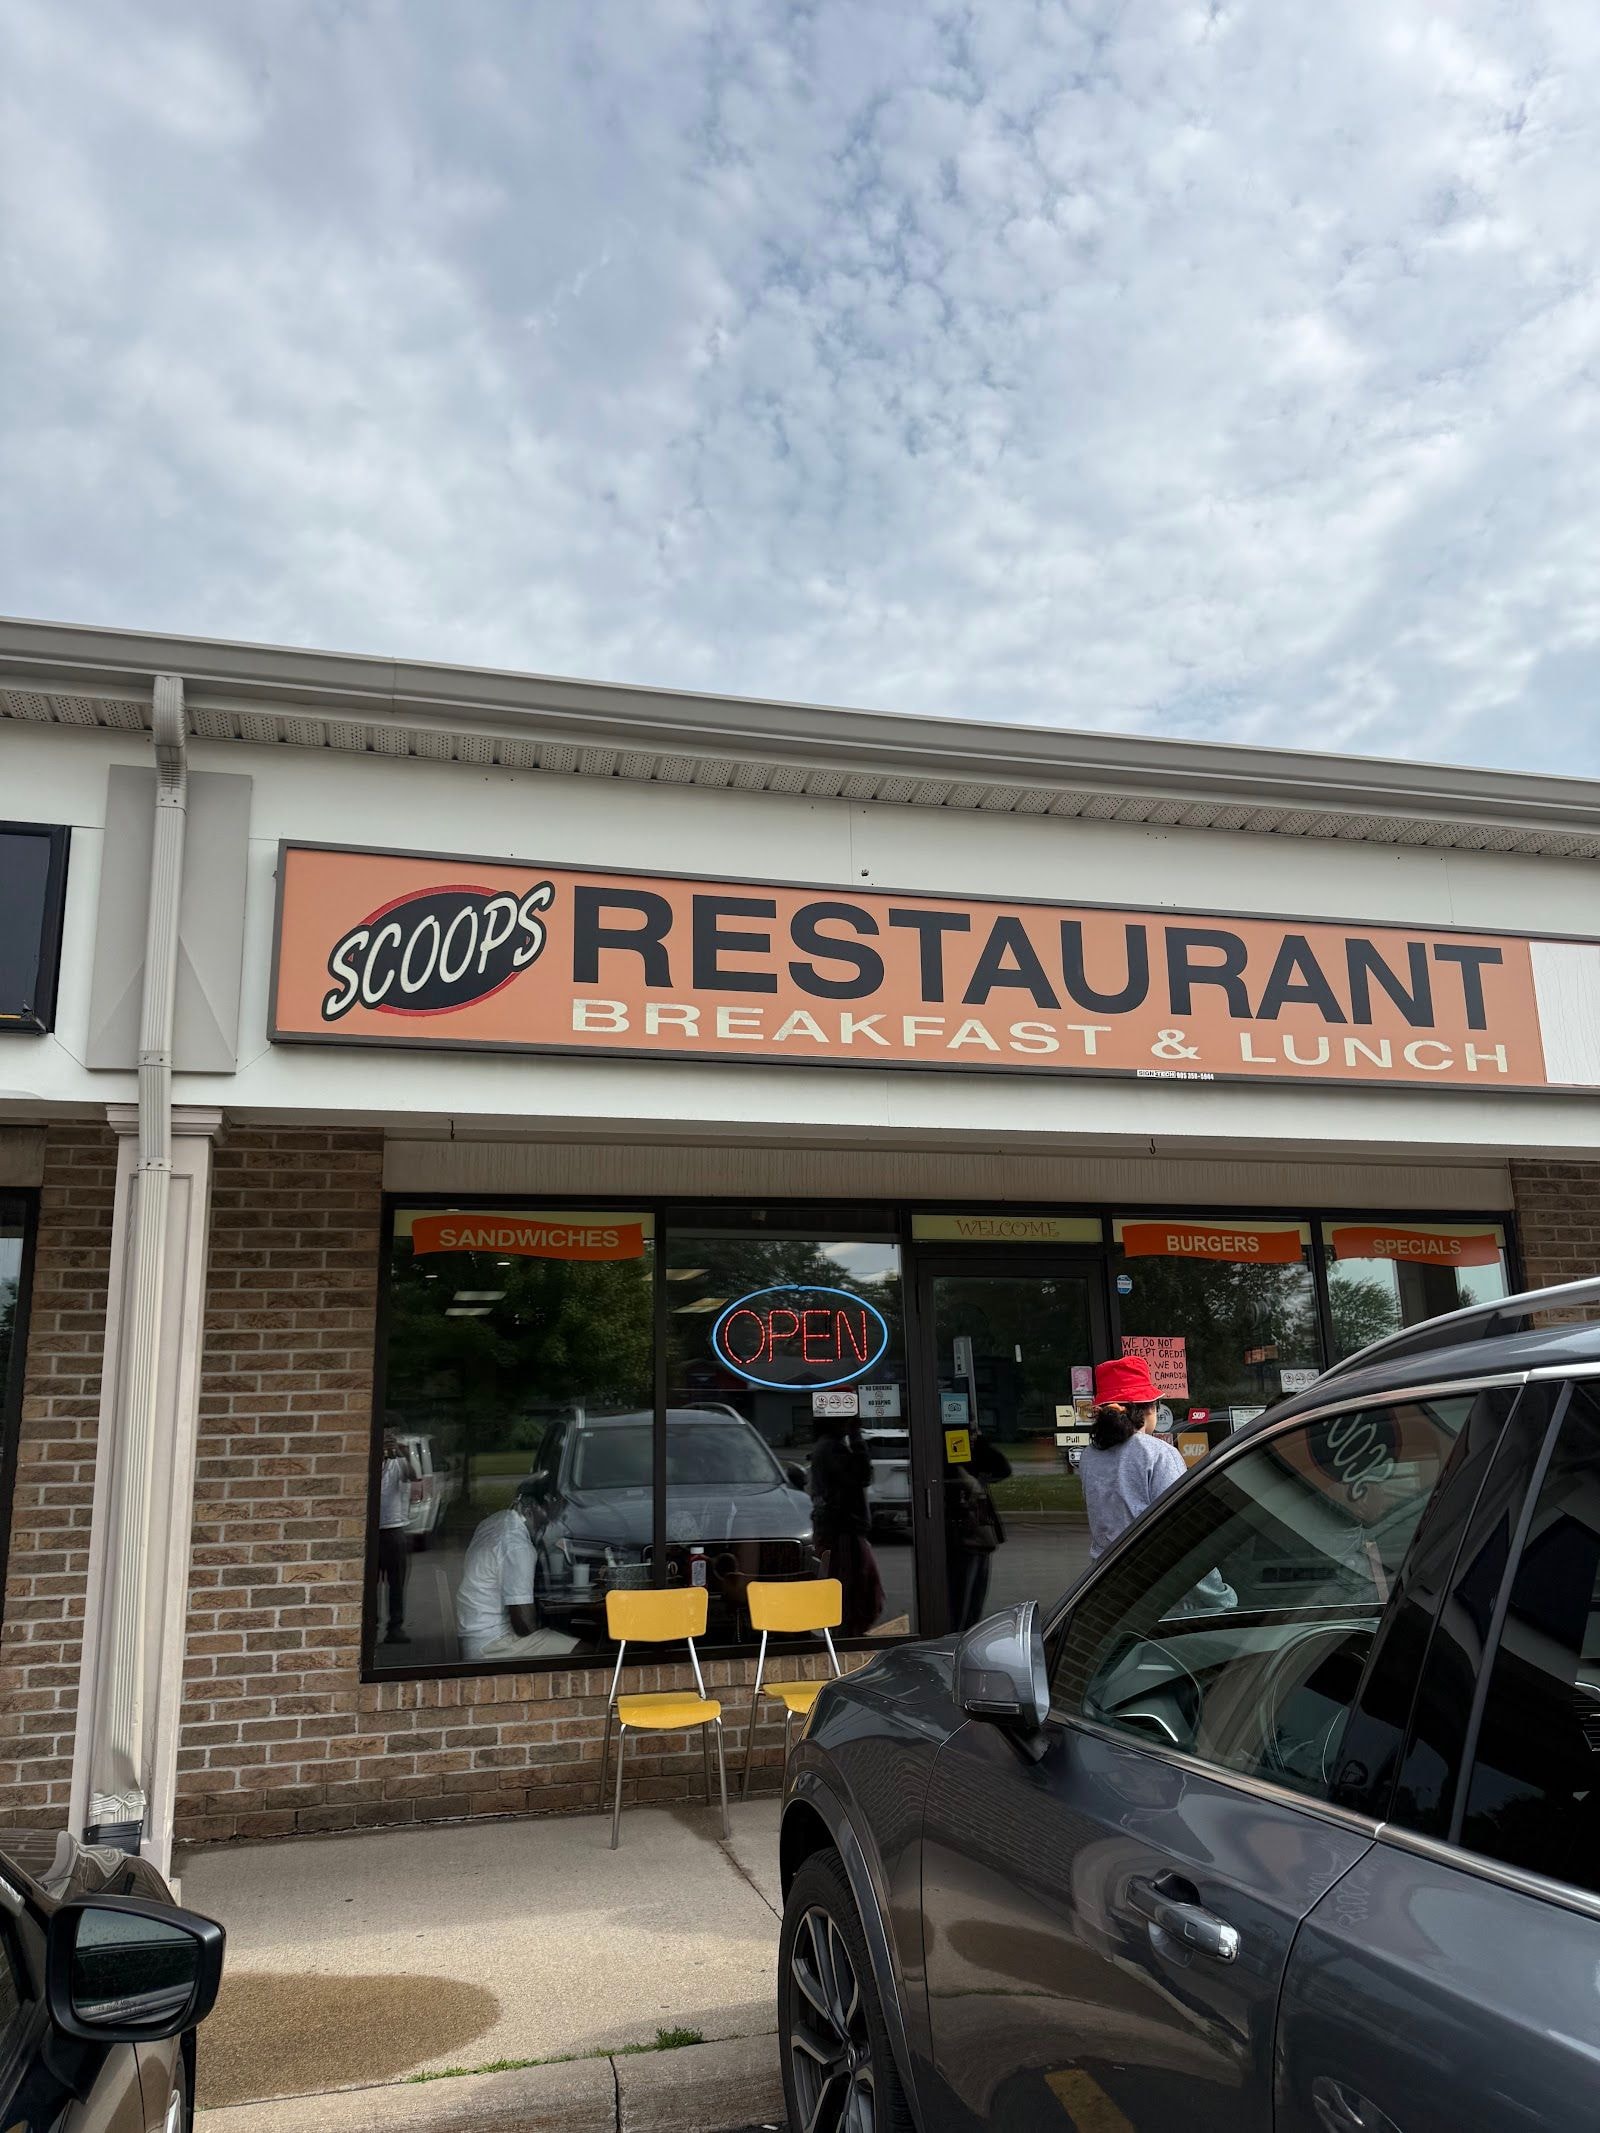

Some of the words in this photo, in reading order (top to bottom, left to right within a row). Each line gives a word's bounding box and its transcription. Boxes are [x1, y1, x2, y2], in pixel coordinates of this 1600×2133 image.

[325, 884, 553, 1017] SCOOPS
[572, 885, 1503, 1031] RESTAURANT
[571, 998, 1112, 1056] BREAKFAST
[1149, 1028, 1202, 1061] &
[1239, 1031, 1509, 1073] LUNCH
[955, 1218, 1060, 1238] WELCOME
[438, 1228, 620, 1248] SANDWICHES
[1166, 1235, 1260, 1253] BURGERS
[1372, 1239, 1463, 1255] SPECIALS
[723, 1309, 868, 1364] OPEN
[1122, 1338, 1138, 1348] WE
[1142, 1338, 1155, 1348] DO
[1158, 1338, 1174, 1348] NOT
[1158, 1349, 1185, 1358] CREDIT
[1154, 1360, 1169, 1369] WE
[1173, 1361, 1184, 1369] DO
[1192, 1412, 1205, 1420] SKIP
[1183, 1443, 1206, 1457] SKIP
